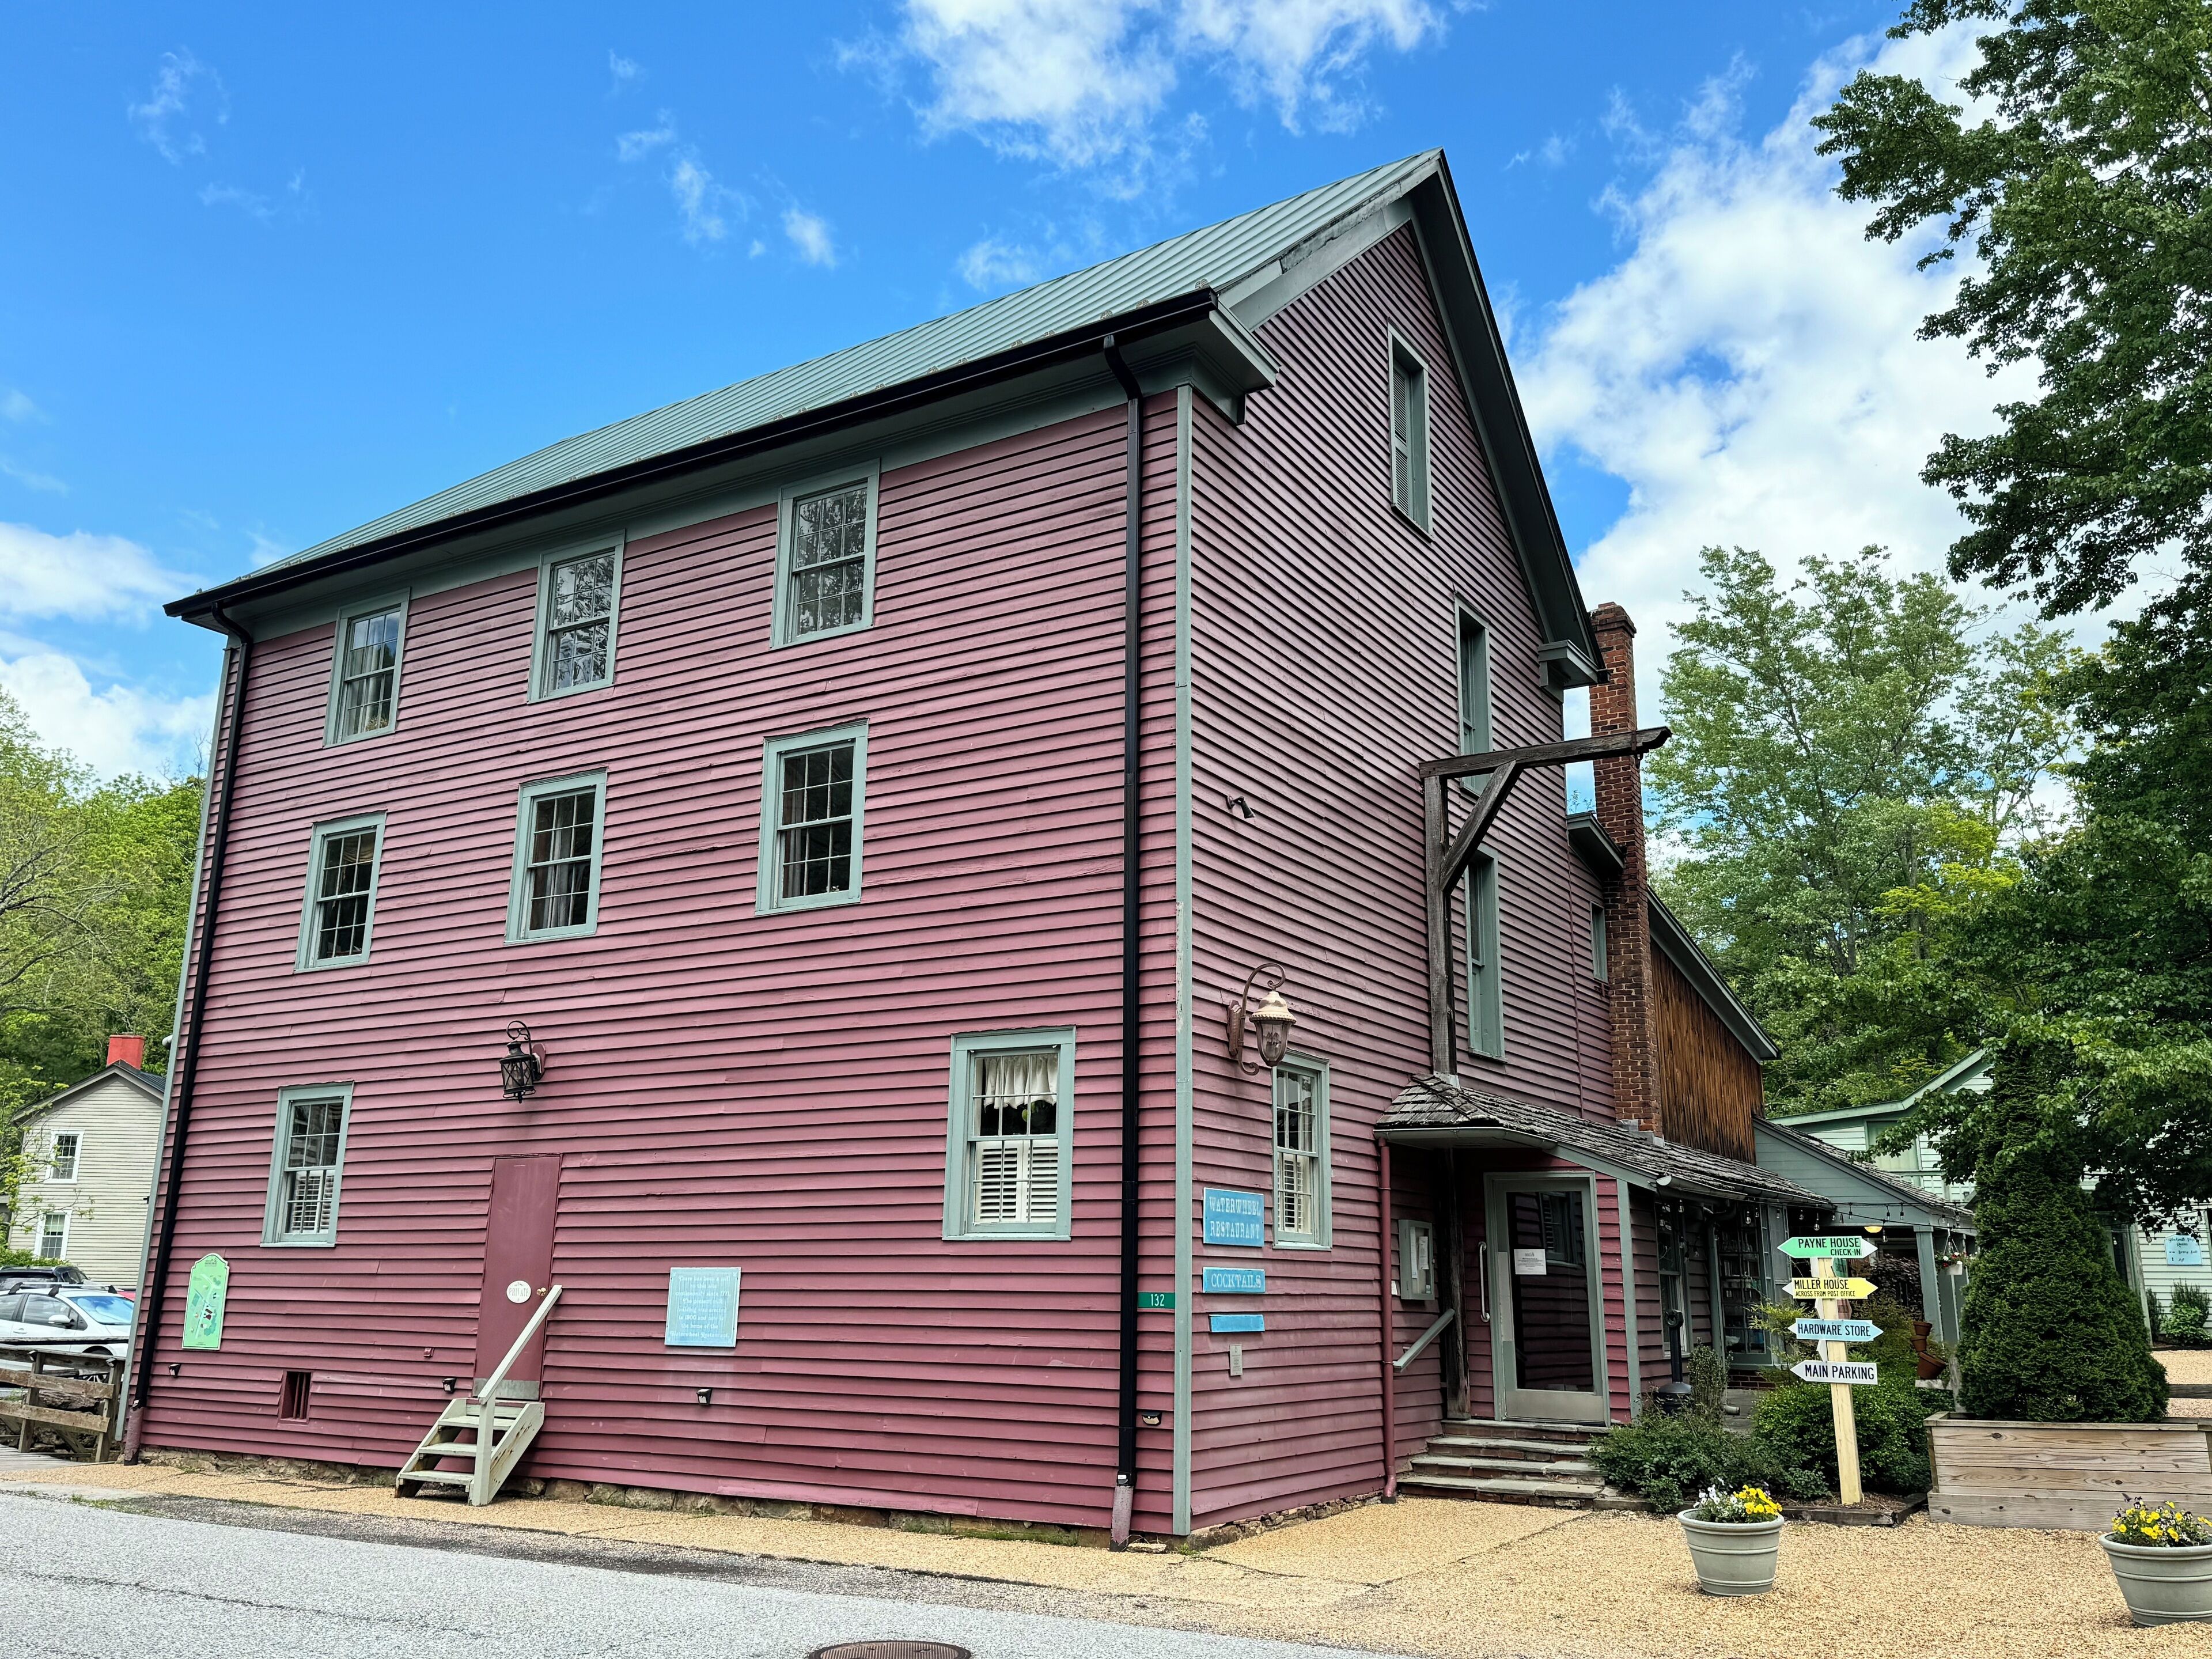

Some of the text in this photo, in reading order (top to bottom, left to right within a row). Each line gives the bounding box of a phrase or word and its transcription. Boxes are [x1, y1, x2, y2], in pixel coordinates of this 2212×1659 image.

[1209, 1196, 1261, 1216] WATERWHEEL
[1210, 1221, 1260, 1239] RESTAURANT
[1798, 1237, 1861, 1248] PAYNE HOUSE
[1211, 1274, 1261, 1288] COCKTAILS
[1794, 1279, 1849, 1289] MILLER HOUSE
[509, 1288, 528, 1297] PRIVATE
[1151, 1294, 1164, 1306] 132
[1798, 1324, 1871, 1336] HARDWARE STORE
[1805, 1364, 1874, 1380] MAIN PARKING
